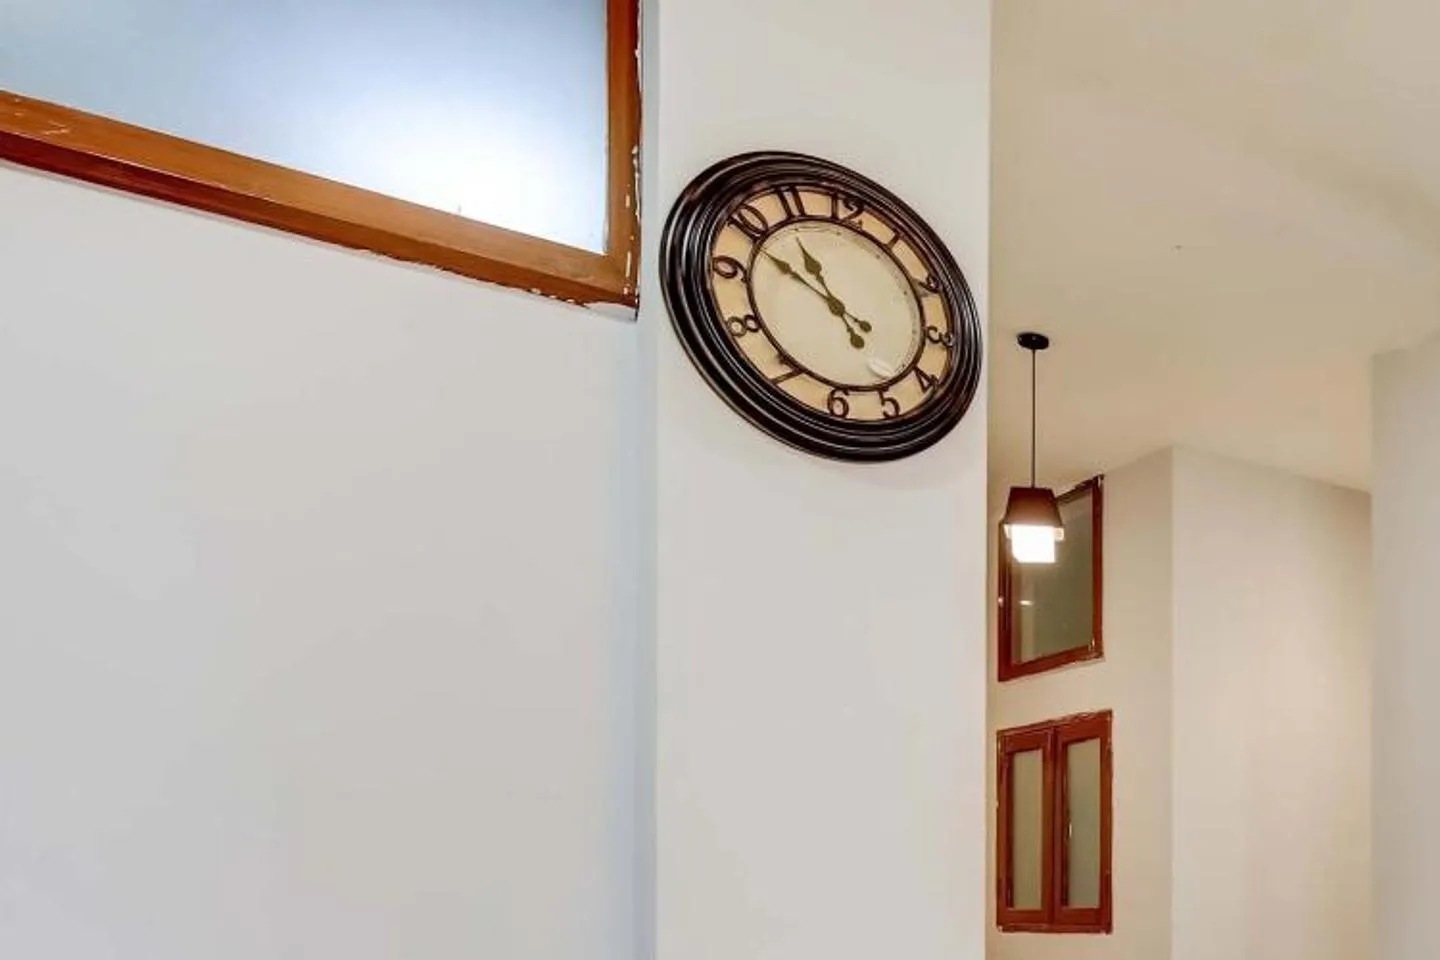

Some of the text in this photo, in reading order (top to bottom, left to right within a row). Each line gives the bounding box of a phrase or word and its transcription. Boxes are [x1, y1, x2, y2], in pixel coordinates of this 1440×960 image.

[775, 186, 806, 219] 11
[829, 191, 864, 230] 12
[726, 200, 769, 243] 10
[885, 229, 905, 251] 1
[711, 255, 750, 284] 9
[911, 271, 941, 298] 2
[726, 314, 760, 338] 8
[924, 325, 955, 348] 3
[769, 351, 805, 385] 7
[912, 364, 940, 393] 4
[827, 388, 850, 419] 6
[878, 390, 900, 419] 5
